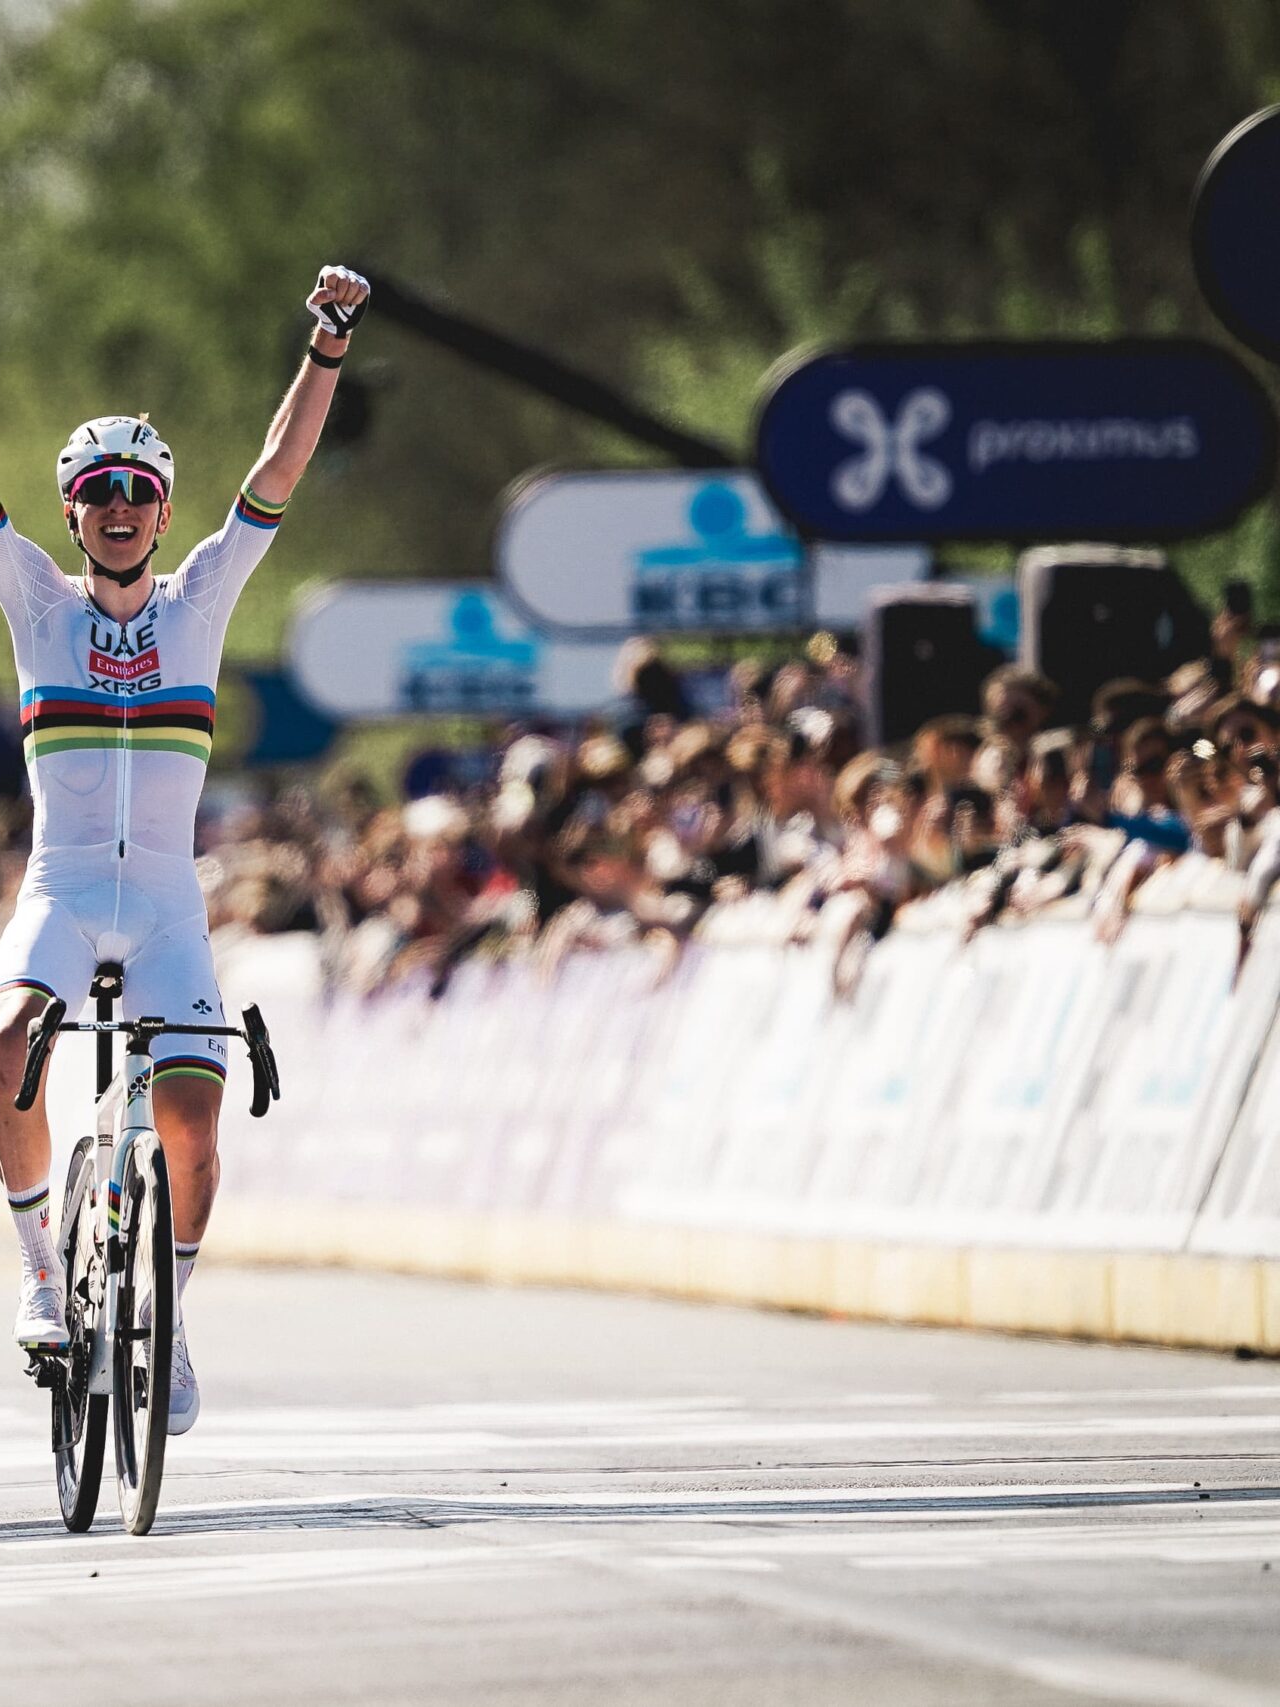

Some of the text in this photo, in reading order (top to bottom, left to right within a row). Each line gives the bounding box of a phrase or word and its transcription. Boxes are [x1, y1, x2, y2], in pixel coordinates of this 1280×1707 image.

[969, 419, 1199, 472] proximus
[90, 622, 156, 657] UAE
[96, 657, 153, 675] Emirates
[88, 673, 161, 695] XRG
